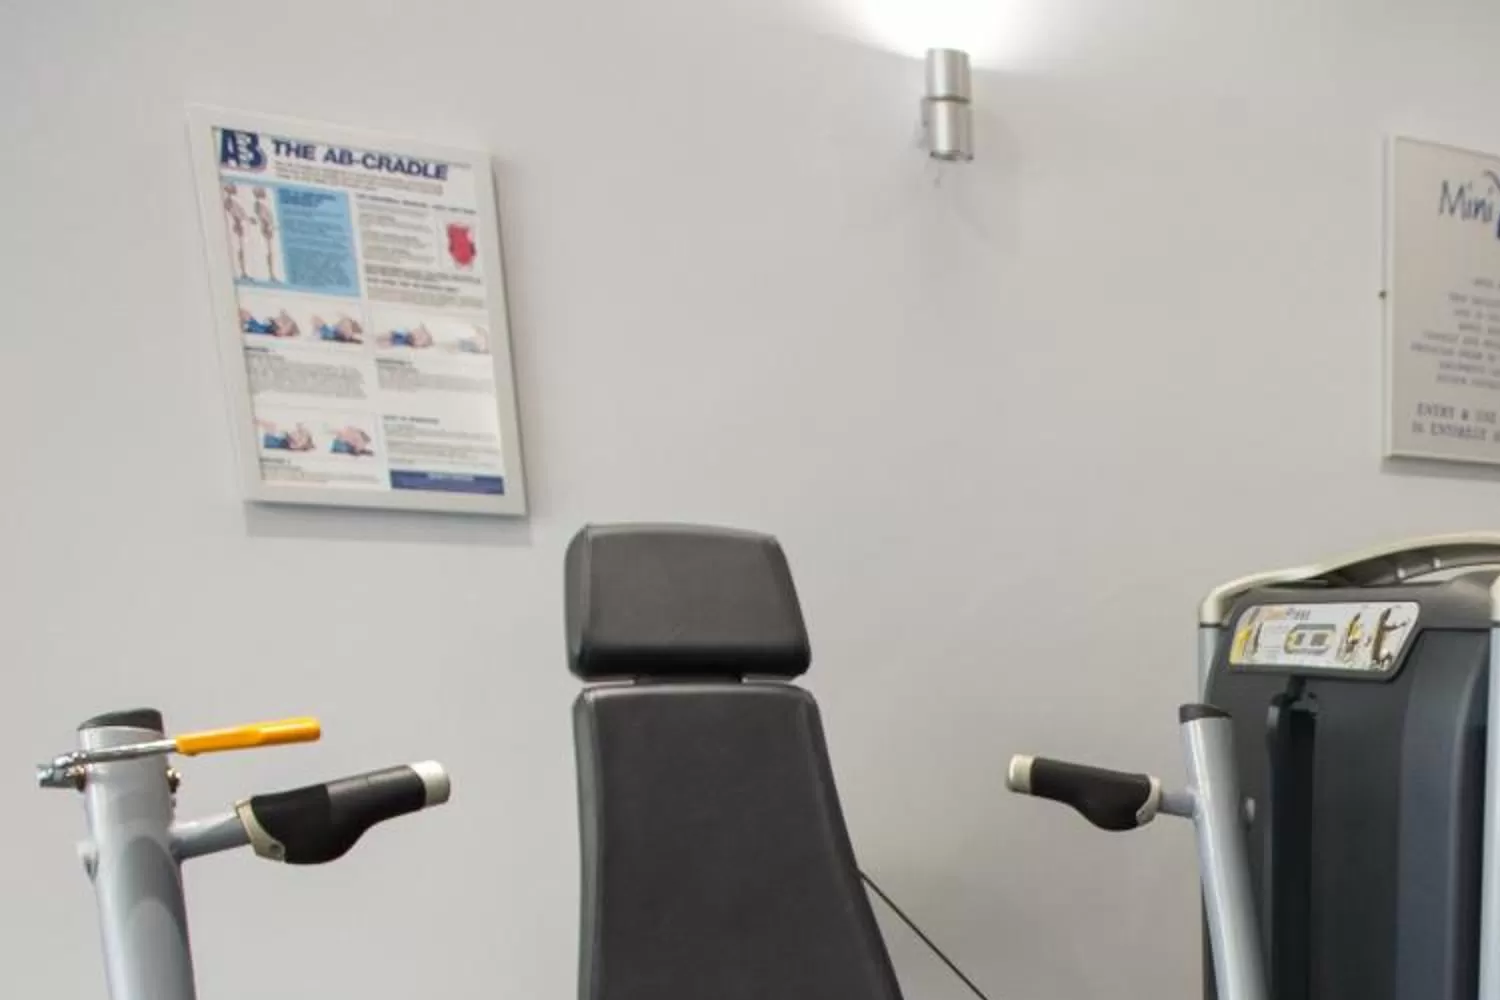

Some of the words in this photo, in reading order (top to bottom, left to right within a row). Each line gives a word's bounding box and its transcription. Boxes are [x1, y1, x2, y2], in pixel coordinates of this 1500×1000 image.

[272, 139, 316, 161] THE
[323, 148, 449, 181] AB-CRADLE
[1438, 179, 1493, 223] Mini
